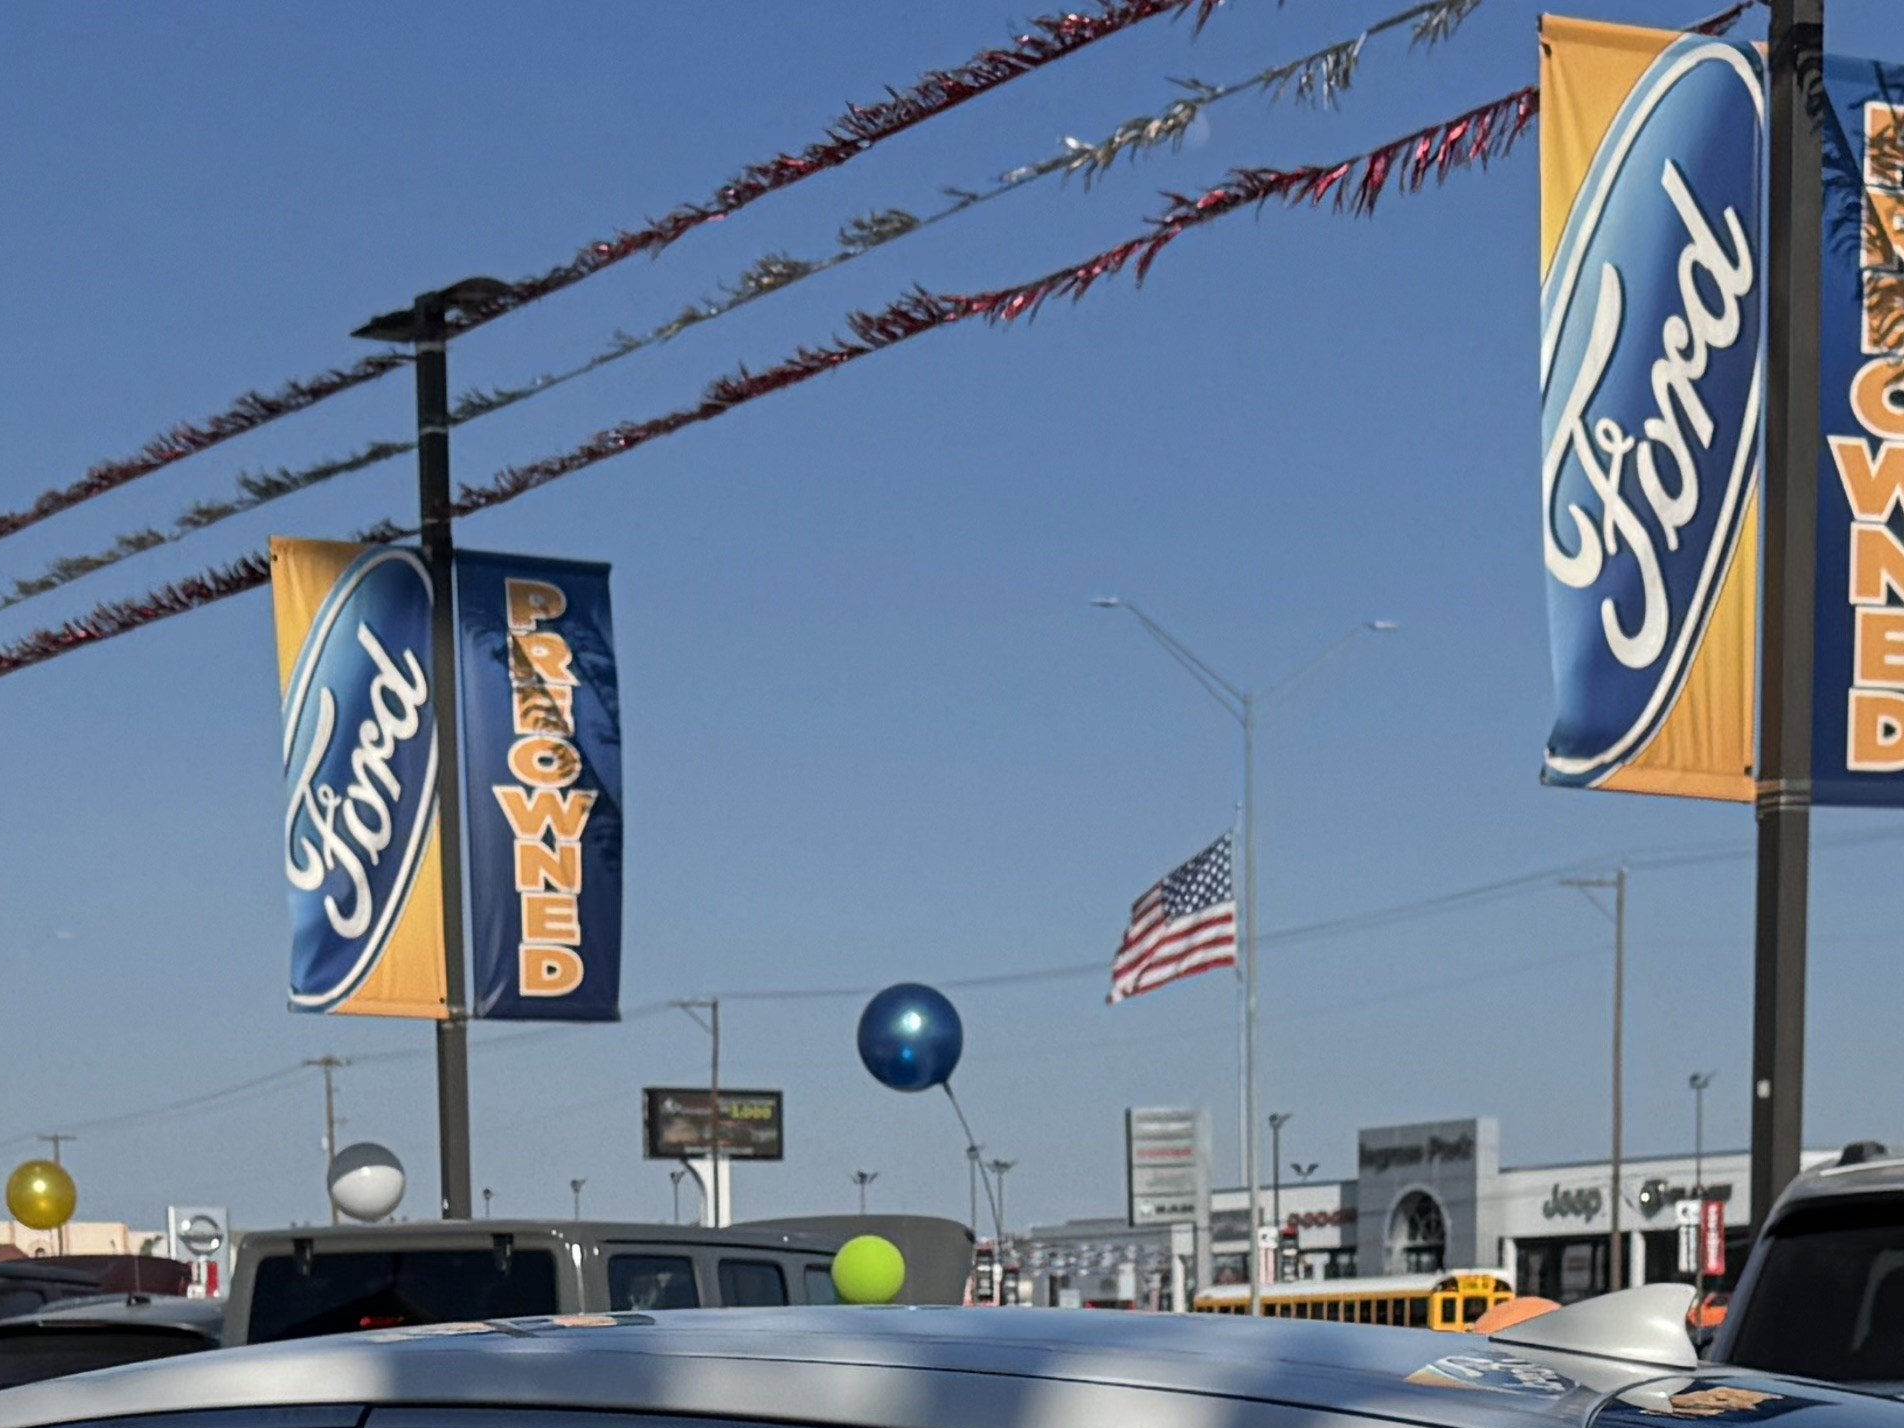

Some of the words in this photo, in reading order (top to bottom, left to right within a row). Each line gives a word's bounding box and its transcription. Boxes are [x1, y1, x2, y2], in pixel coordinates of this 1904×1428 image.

[1545, 160, 1754, 669] Ford
[285, 621, 428, 939] Ford
[1543, 1183, 1602, 1223] Jeep
